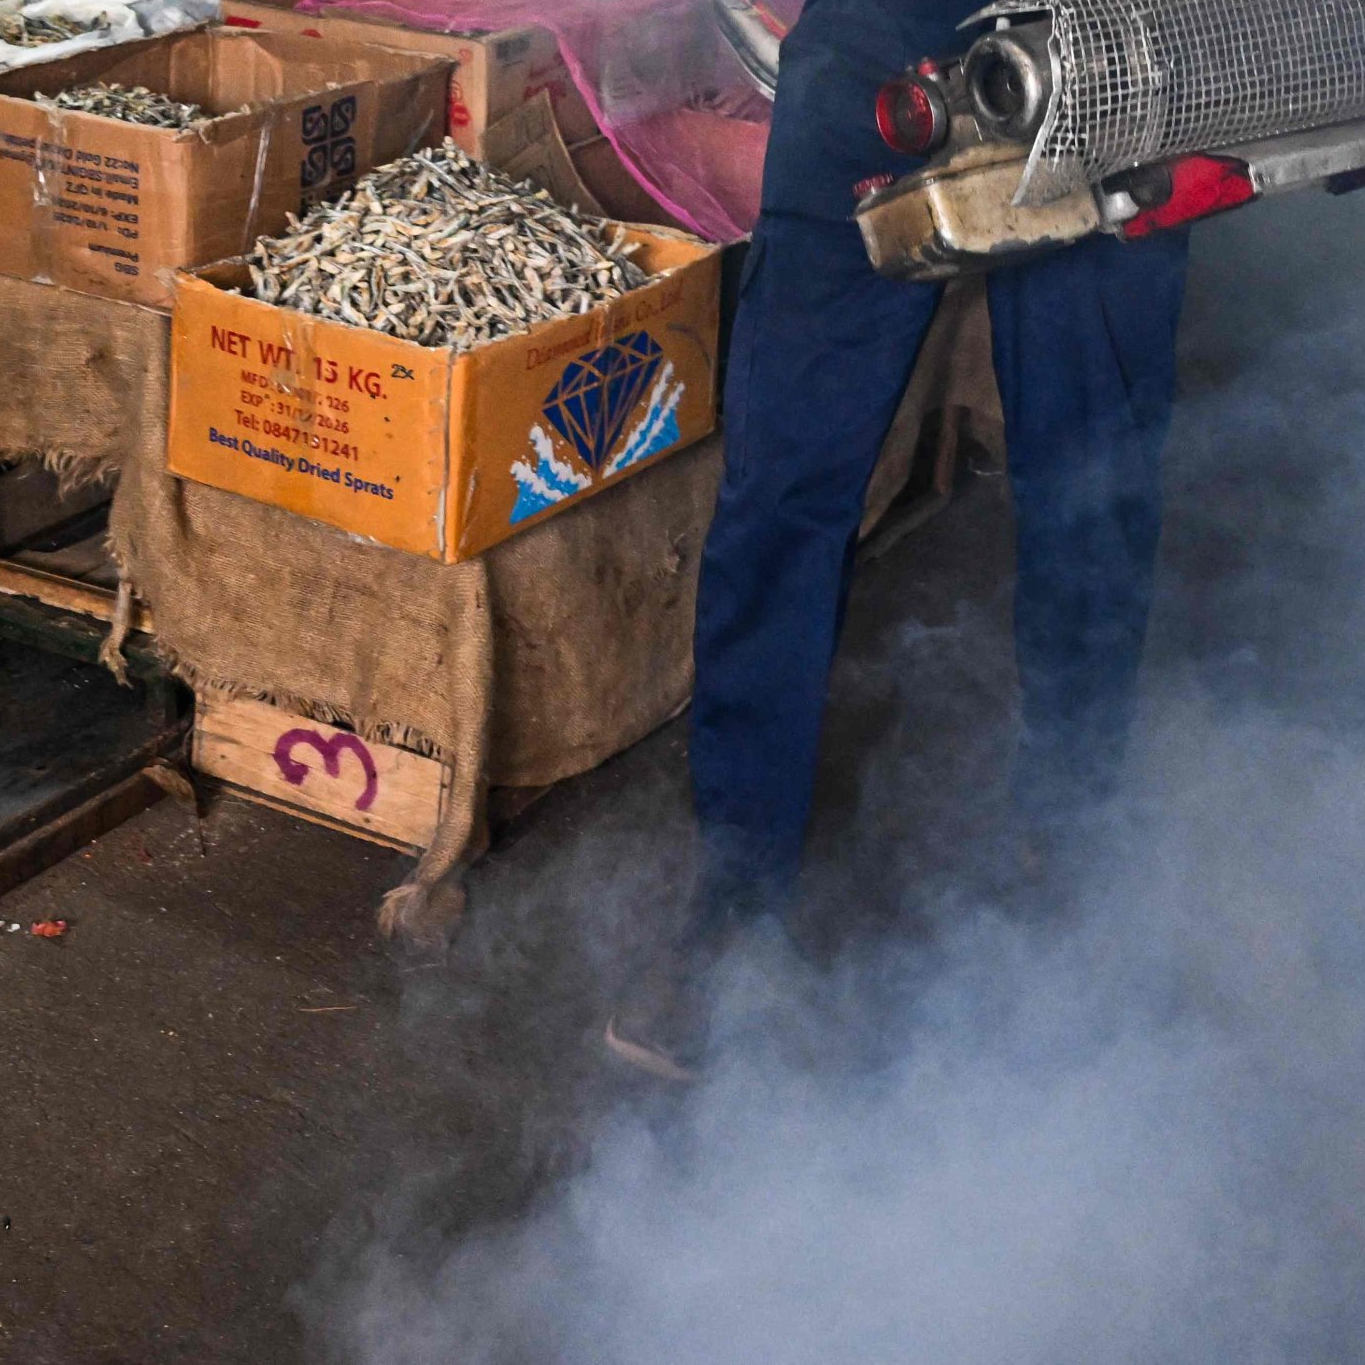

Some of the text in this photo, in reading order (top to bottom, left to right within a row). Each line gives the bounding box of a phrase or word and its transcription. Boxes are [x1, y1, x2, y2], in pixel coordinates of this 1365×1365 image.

[211, 325, 251, 359] NET
[258, 340, 301, 375] WT.
[313, 356, 338, 384] 15
[348, 366, 388, 399] KG.
[235, 409, 261, 432] Tel:
[209, 426, 395, 501] Best Quality Dried Sprats
